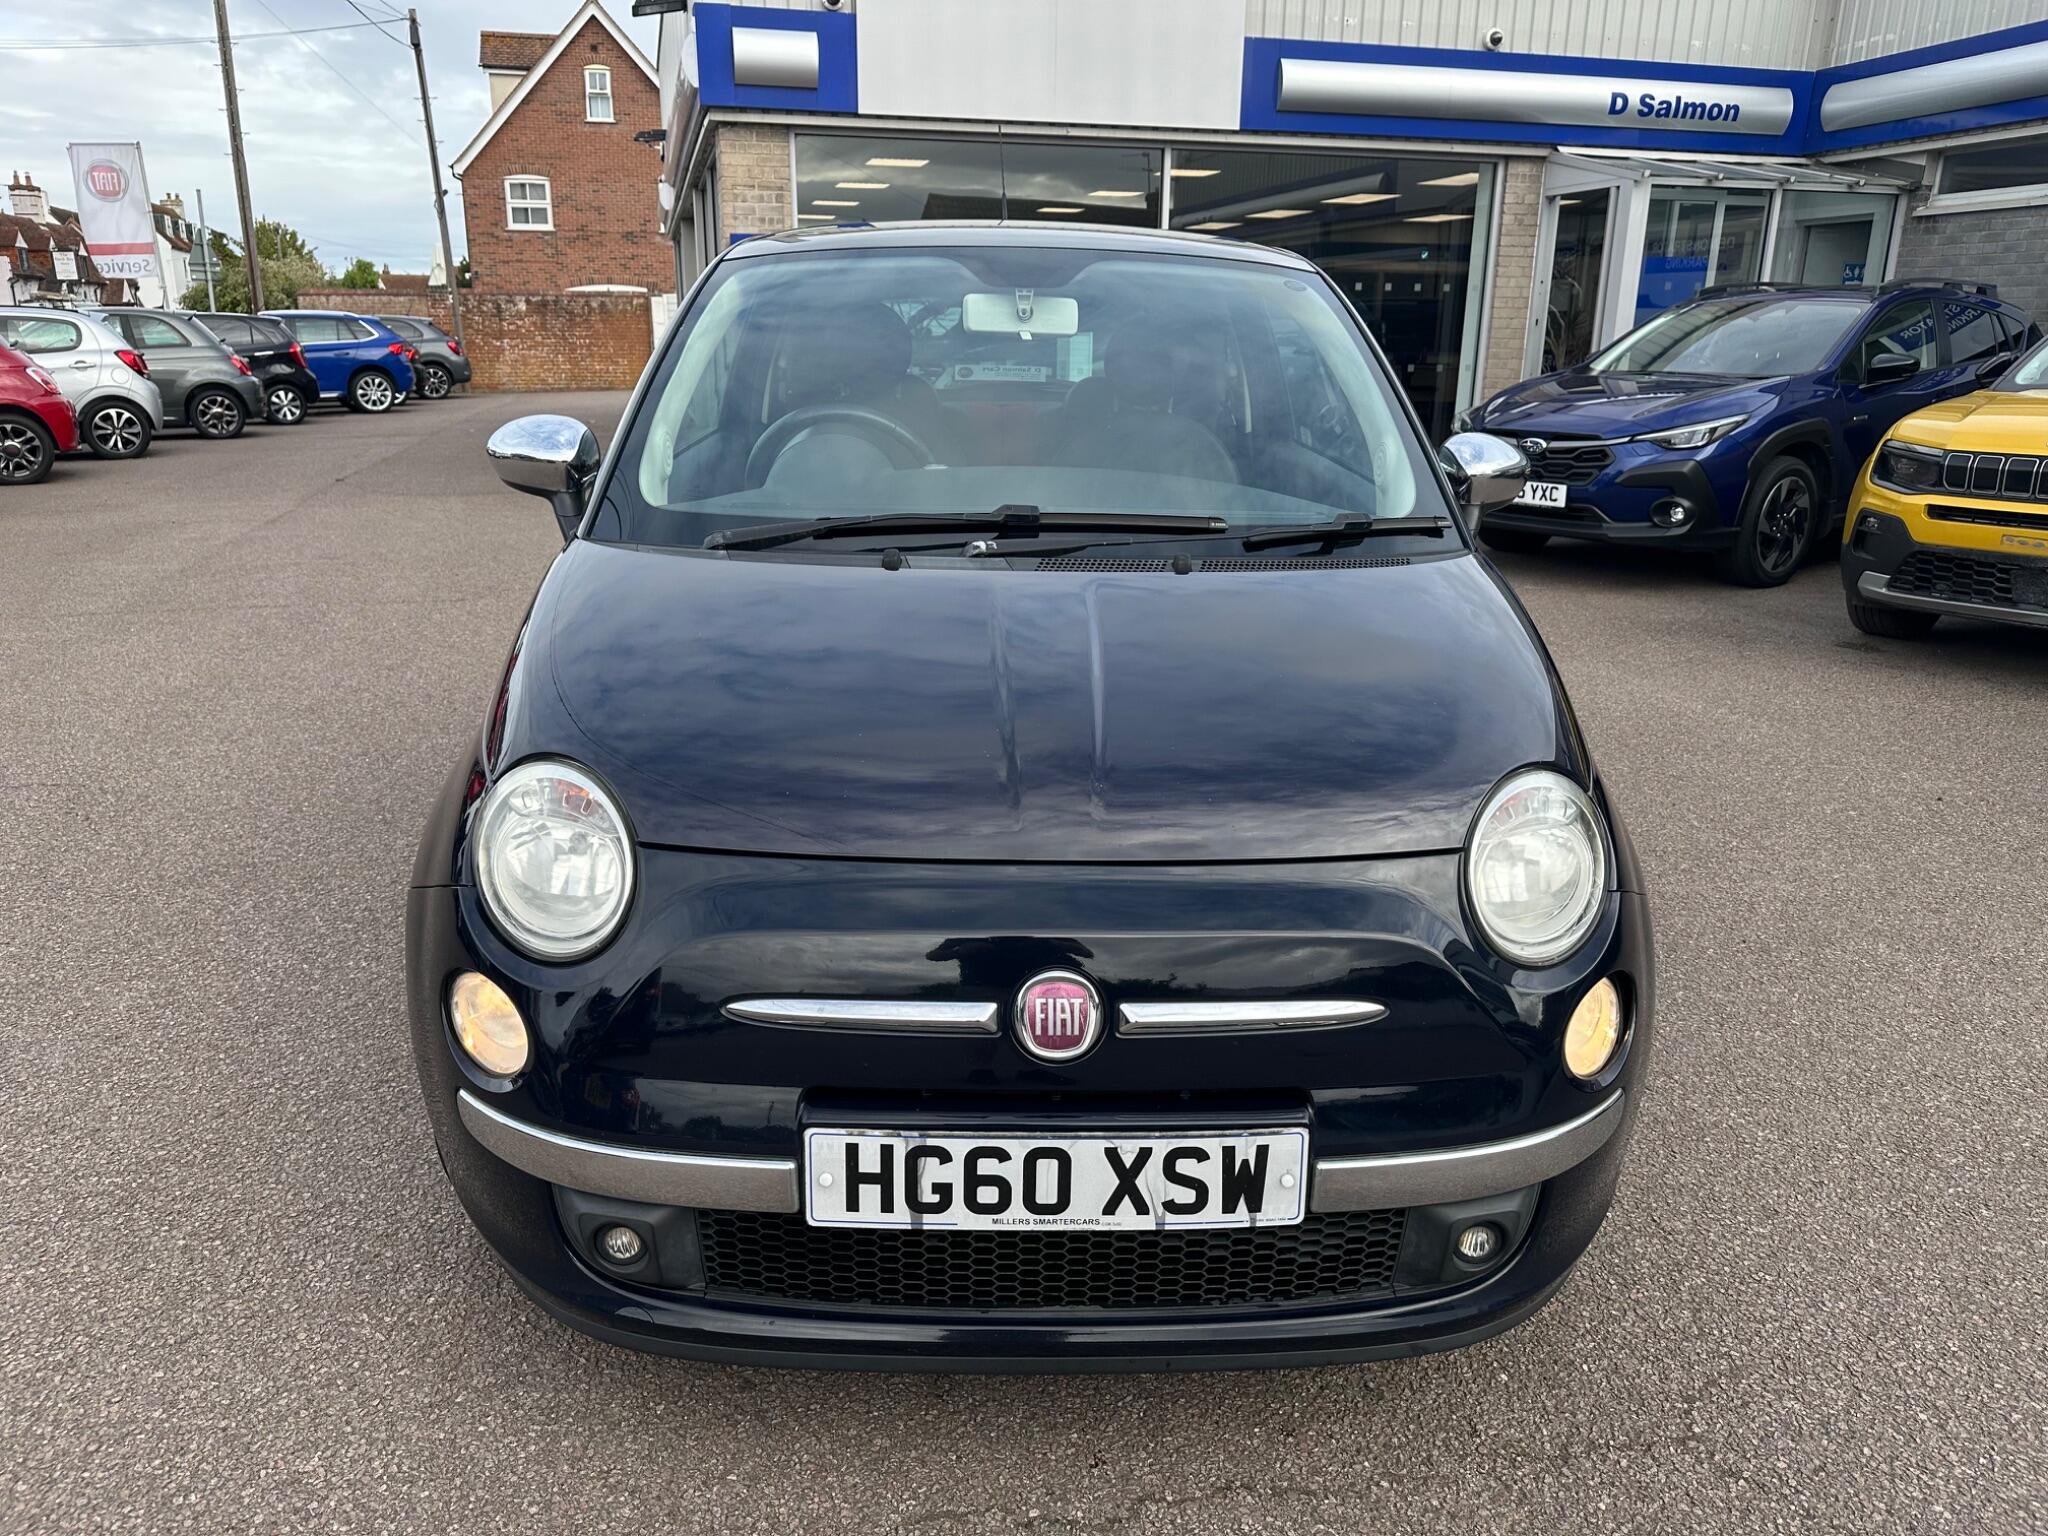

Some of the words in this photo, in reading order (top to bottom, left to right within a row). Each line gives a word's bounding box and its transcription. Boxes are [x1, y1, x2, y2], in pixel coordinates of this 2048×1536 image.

[1607, 91, 1629, 116] D
[1637, 93, 1740, 122] Salmon
[1530, 483, 1559, 502] YXC
[1034, 997, 1084, 1036] FIAT
[845, 1142, 1072, 1215] HG60
[1101, 1143, 1269, 1215] XSW
[991, 1217, 1031, 1226] MILLERS
[1033, 1218, 1100, 1226] SMARTERCARS
